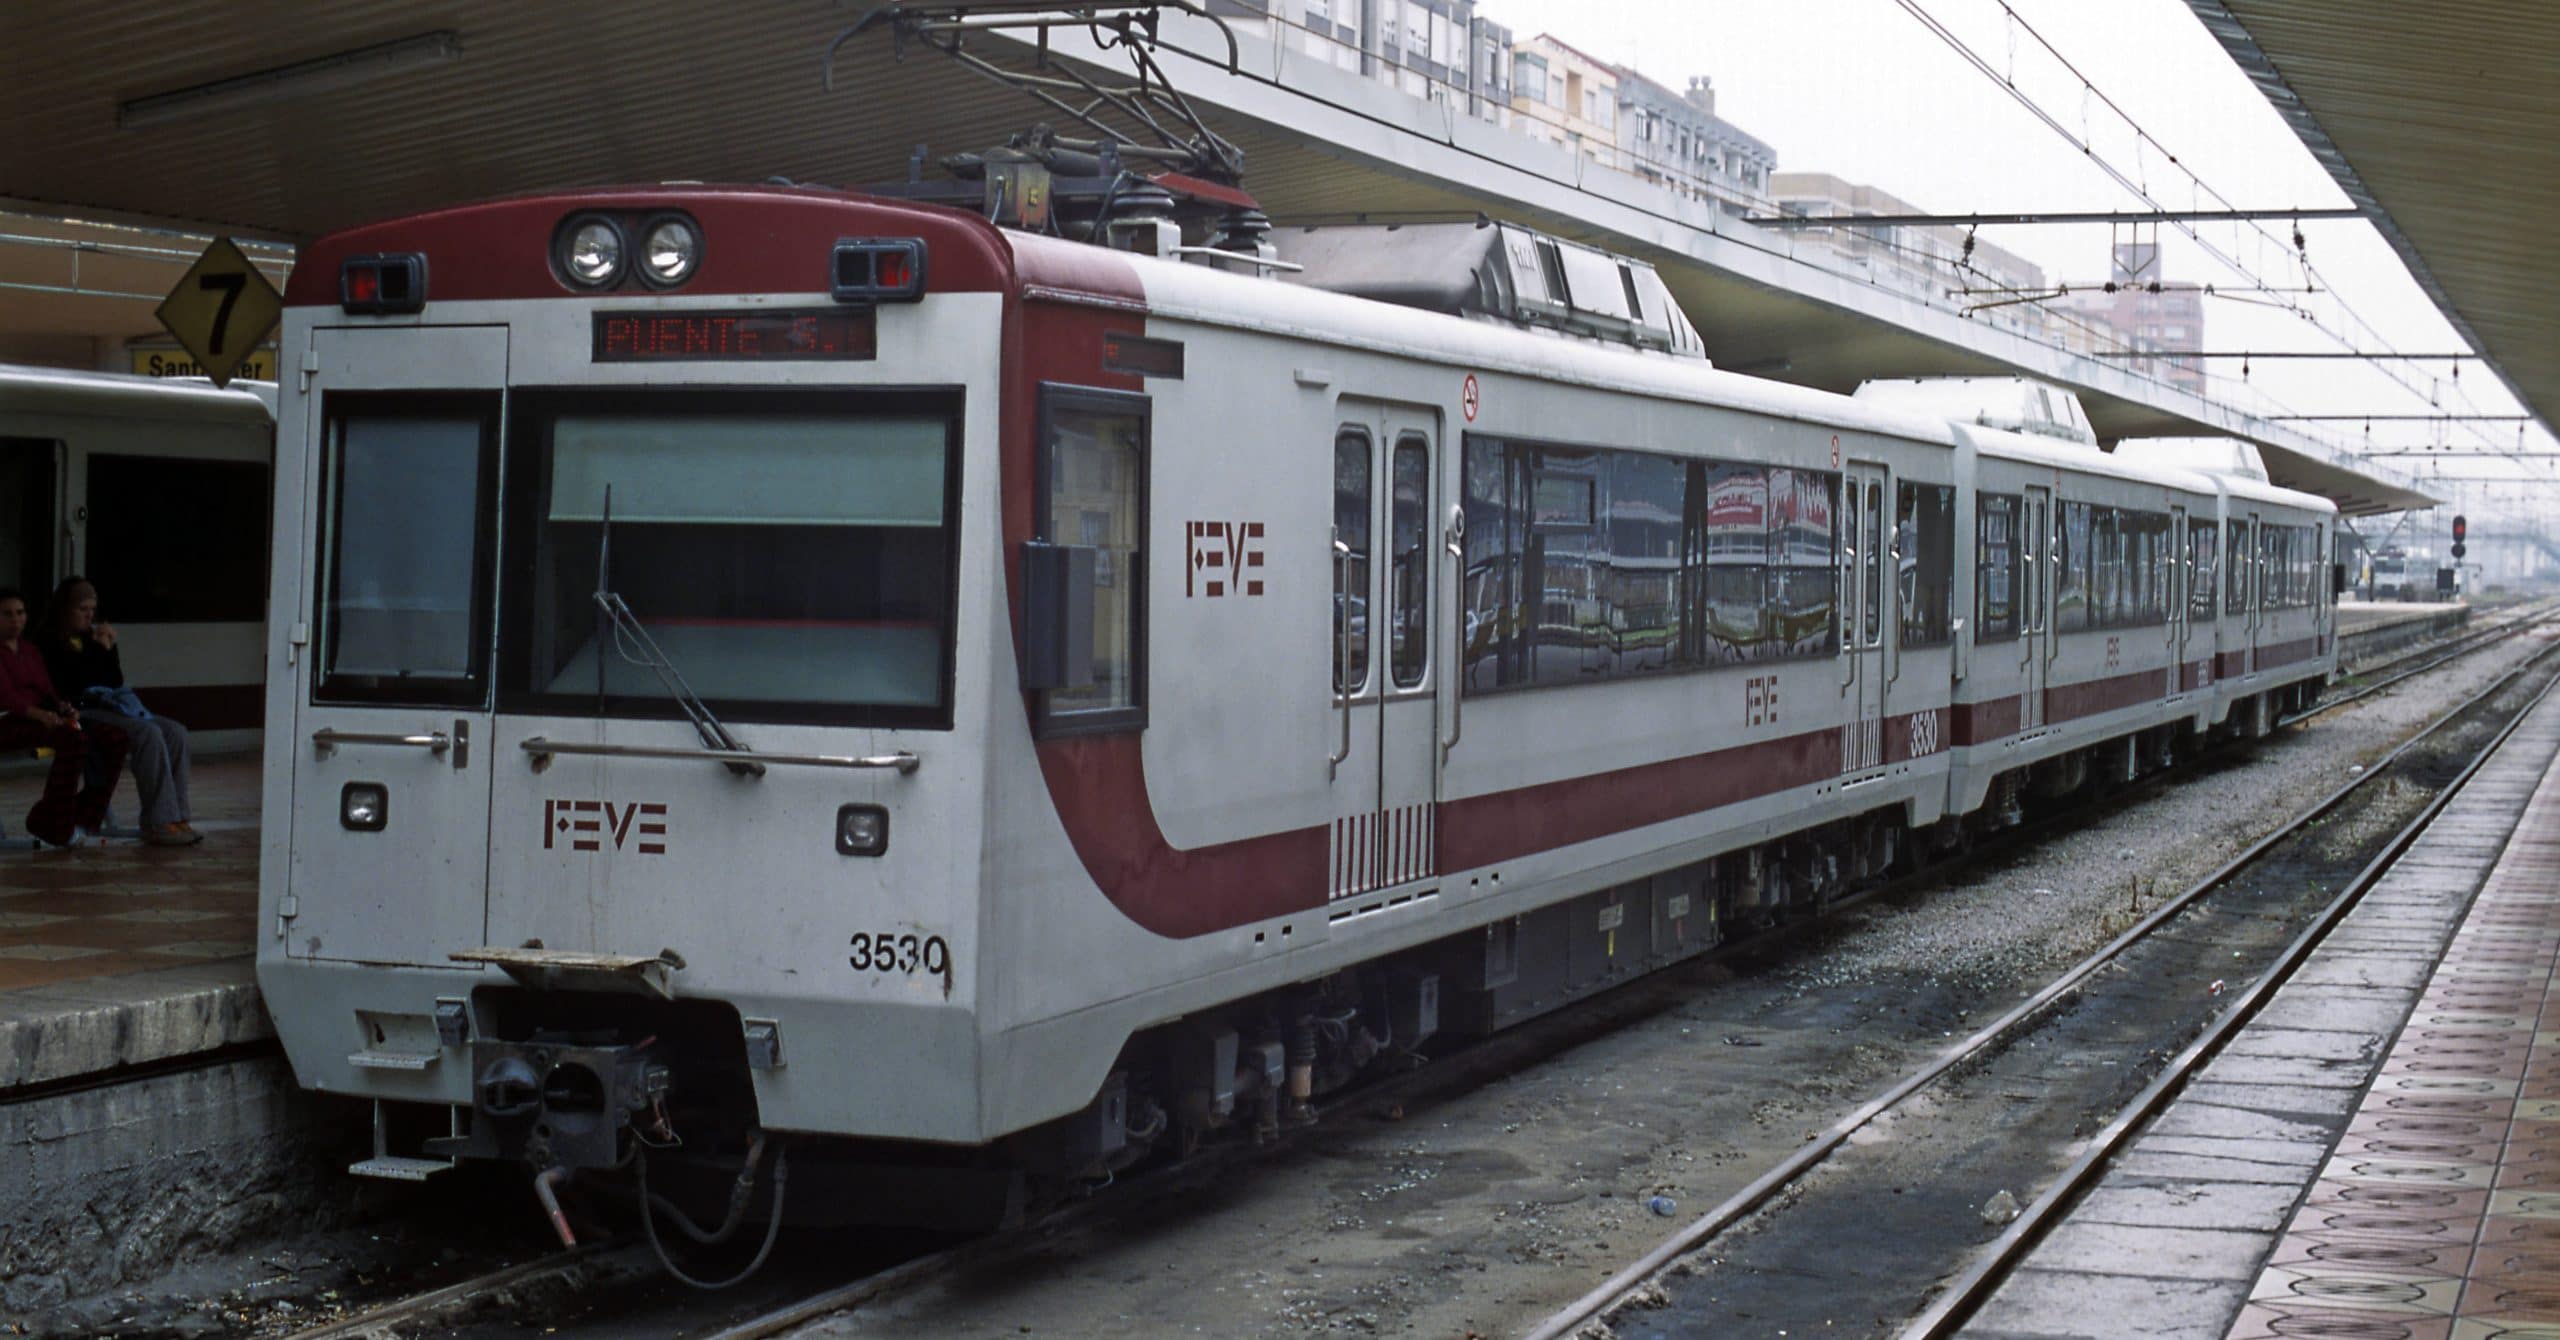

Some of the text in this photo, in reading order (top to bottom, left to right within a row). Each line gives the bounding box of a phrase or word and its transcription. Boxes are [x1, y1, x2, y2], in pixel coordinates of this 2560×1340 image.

[199, 272, 247, 356] 7
[1186, 521, 1264, 597] FEVE
[1746, 675, 1777, 728] FEVE
[1911, 709, 1937, 758] 3530
[544, 799, 667, 854] FEVE
[850, 932, 951, 975] 3530
